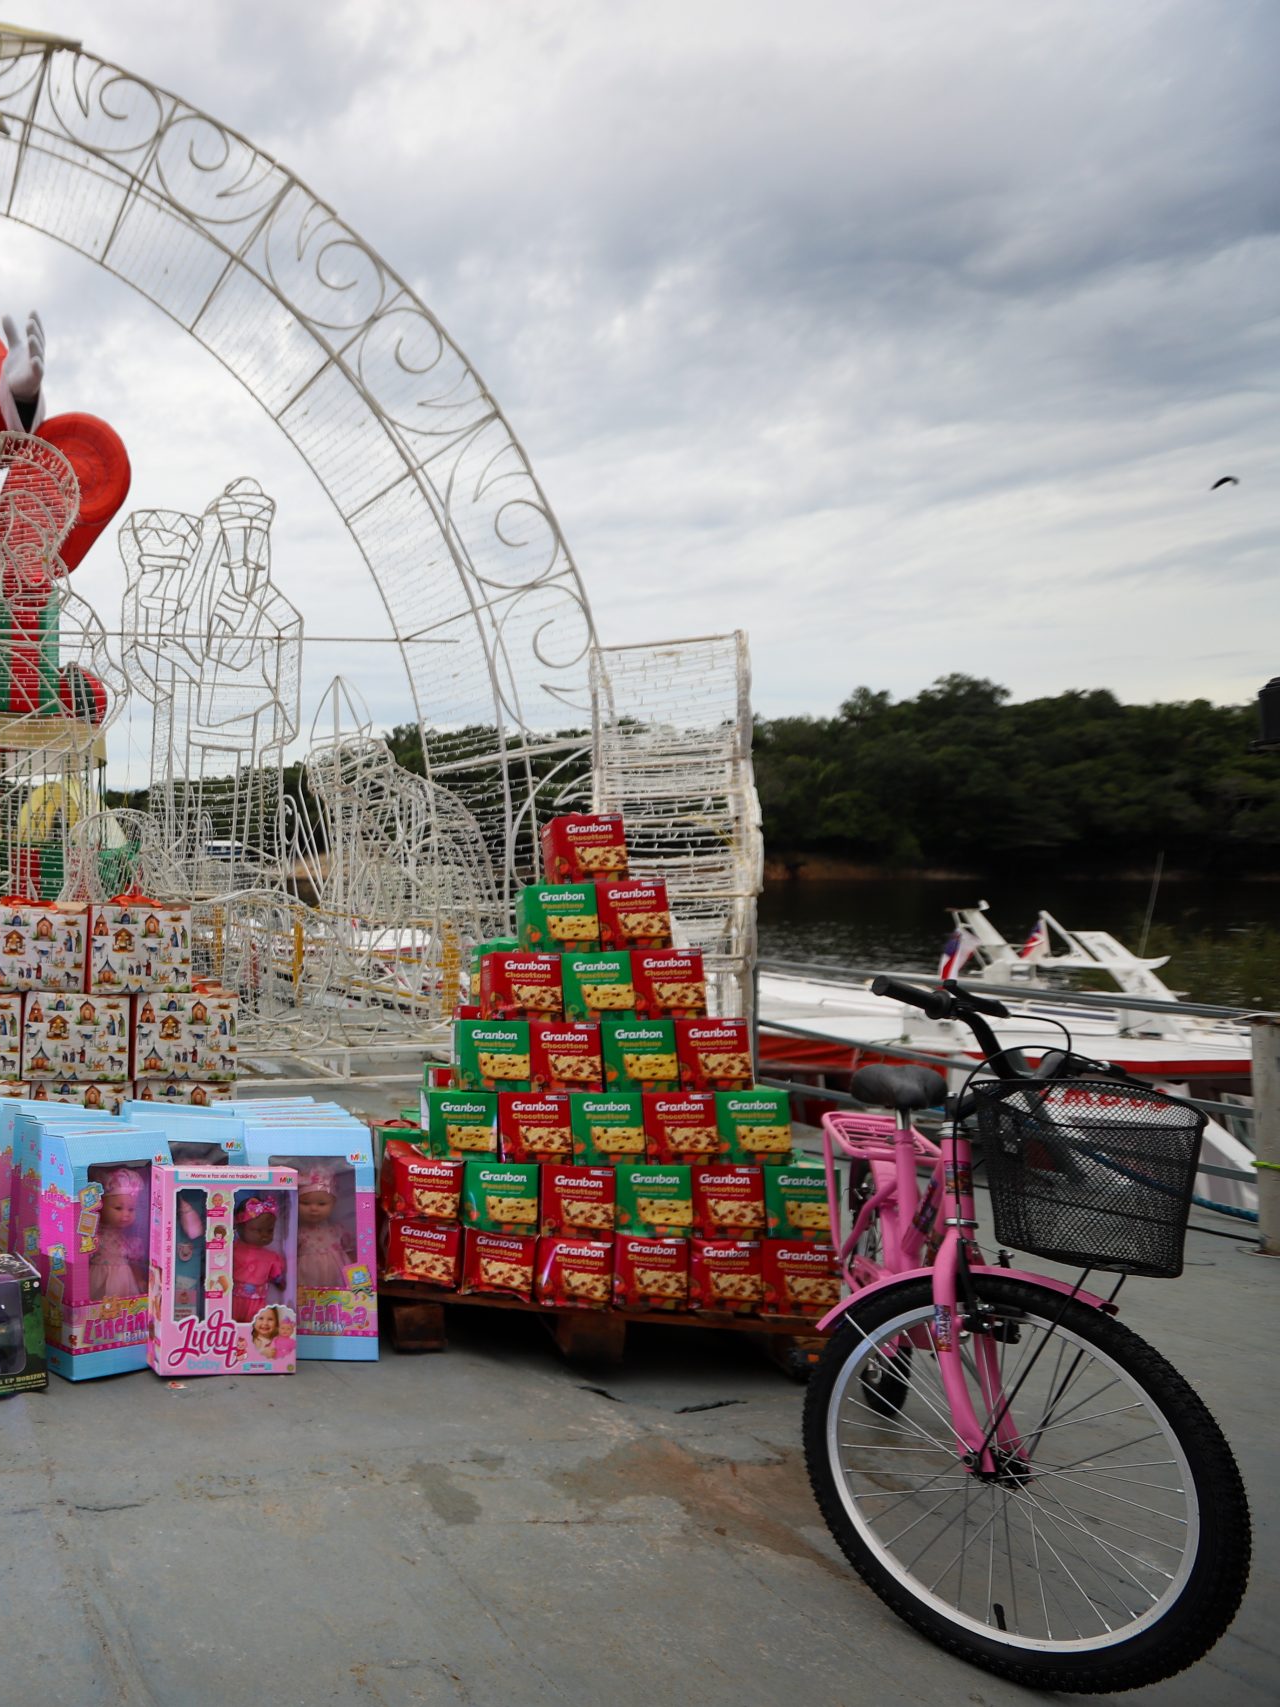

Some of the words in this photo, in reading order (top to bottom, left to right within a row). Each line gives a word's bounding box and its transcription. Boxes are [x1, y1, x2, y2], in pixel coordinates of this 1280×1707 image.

[566, 823, 612, 834] Granbon
[539, 892, 585, 902] Granbon
[608, 889, 655, 899] Granbon
[504, 960, 551, 971] Granbon
[573, 961, 620, 971] Granbon
[643, 958, 691, 969] Granbon
[472, 1029, 518, 1041] Granbon
[540, 1031, 588, 1042] Granbon
[615, 1029, 663, 1039] Granbon
[688, 1028, 737, 1039] Granbon
[440, 1101, 486, 1113] Granbon
[511, 1101, 559, 1112] Granbon
[583, 1101, 631, 1112] Granbon
[655, 1101, 704, 1112] Granbon
[727, 1100, 778, 1110] Granbon
[408, 1165, 453, 1177] Granbon
[479, 1170, 527, 1182] Granbon
[554, 1175, 603, 1188] Granbon
[630, 1173, 680, 1184] Granbon
[699, 1173, 750, 1185] Granbon
[778, 1175, 827, 1187] Granbon
[401, 1225, 447, 1241] Granbon
[477, 1235, 523, 1250] Granbon
[556, 1243, 605, 1258] Granbon
[628, 1242, 677, 1255] Granbon
[703, 1247, 749, 1258] Granbon
[777, 1250, 828, 1261] Granbon
[299, 1298, 368, 1327] dinha
[83, 1309, 149, 1344] Lindin
[168, 1309, 238, 1369] Judy
[187, 1358, 220, 1371] baby
